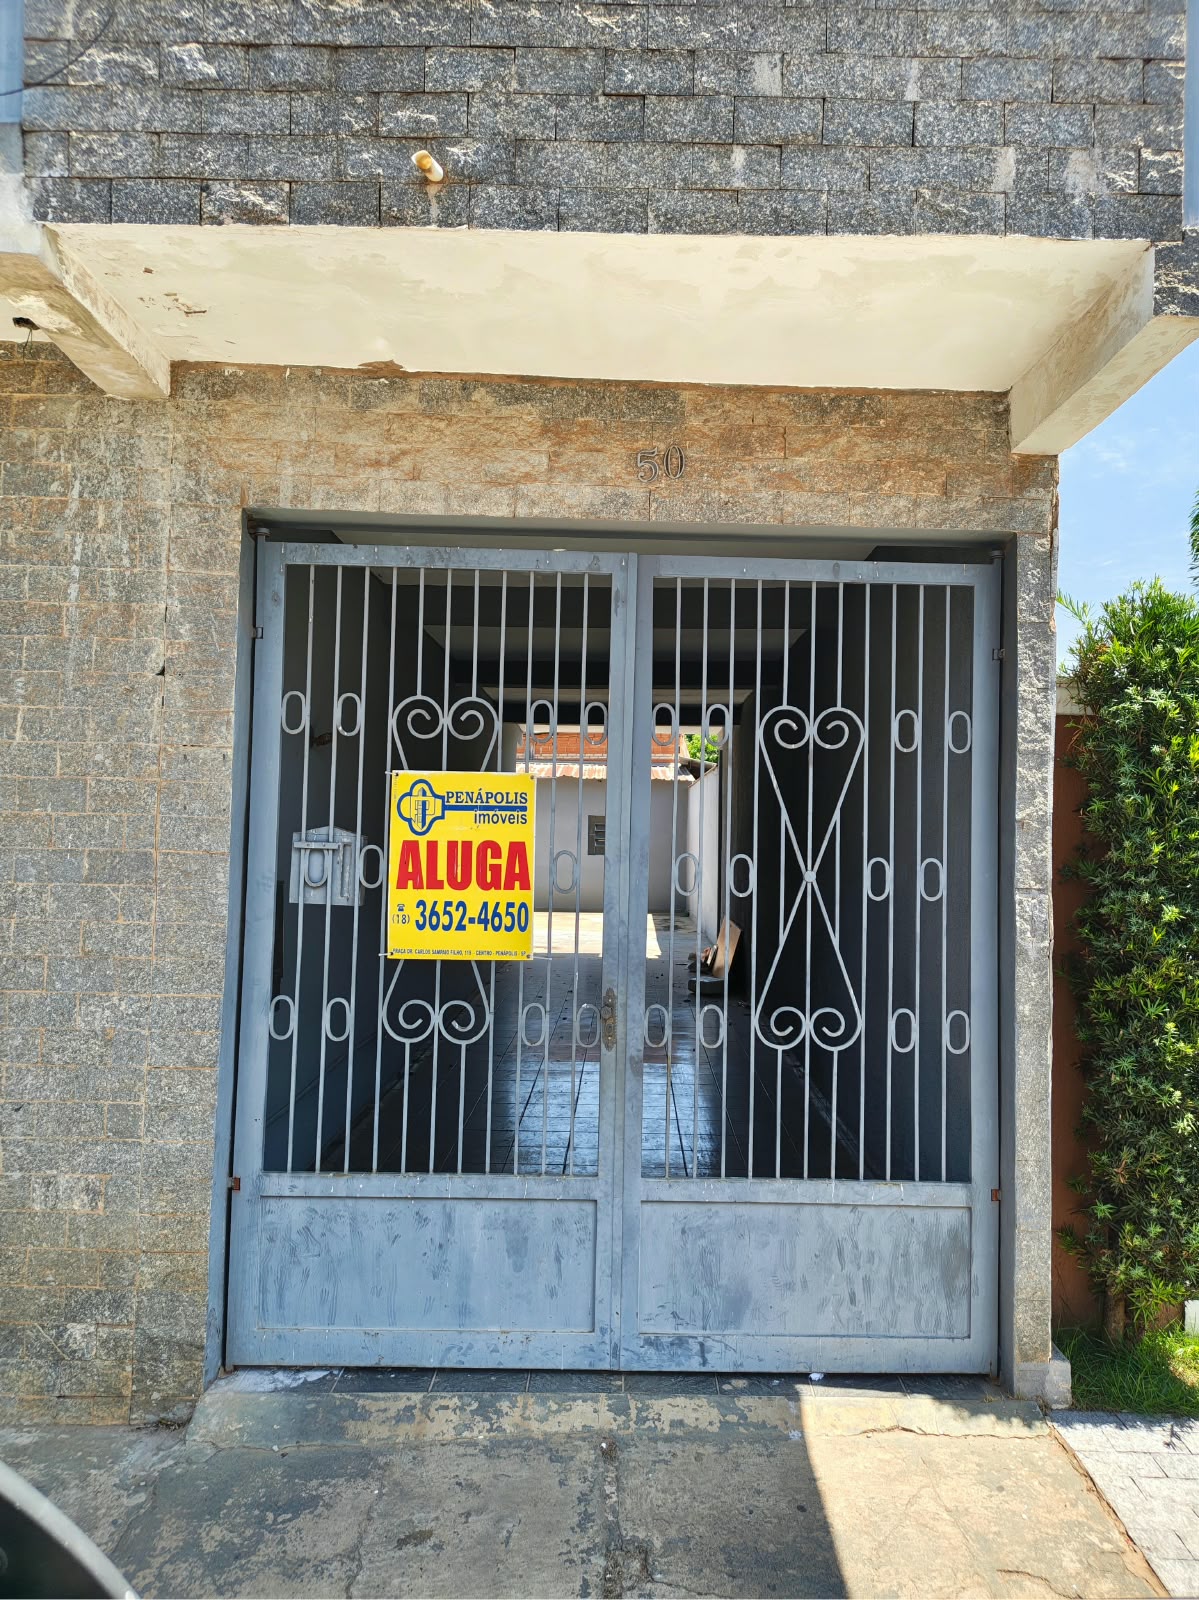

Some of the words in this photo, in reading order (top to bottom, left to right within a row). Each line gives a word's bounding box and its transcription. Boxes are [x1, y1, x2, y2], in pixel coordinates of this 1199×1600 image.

[637, 445, 685, 482] 50
[445, 788, 528, 804] PENÁPOLIS
[474, 808, 528, 825] imóveis
[396, 839, 531, 891] ALUGA
[392, 914, 410, 925] (18)
[415, 899, 529, 932] 3652-4650
